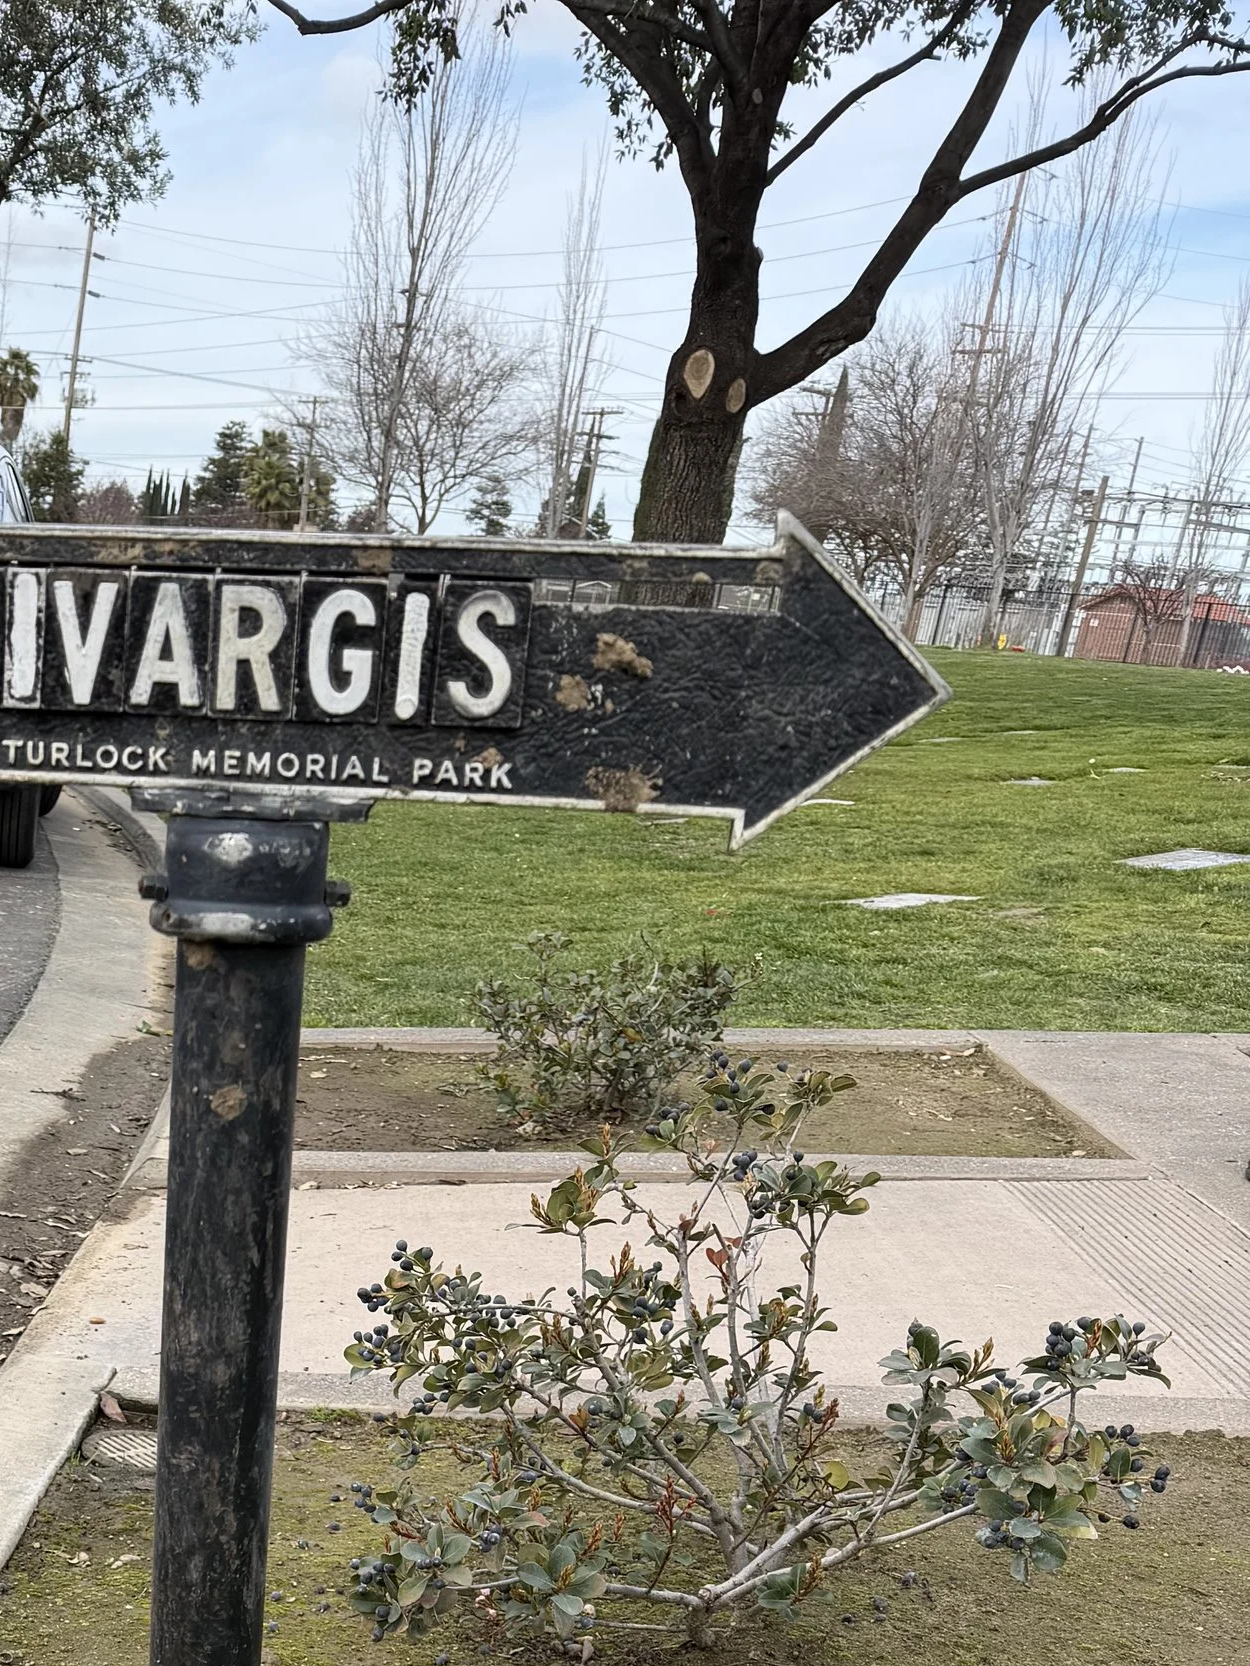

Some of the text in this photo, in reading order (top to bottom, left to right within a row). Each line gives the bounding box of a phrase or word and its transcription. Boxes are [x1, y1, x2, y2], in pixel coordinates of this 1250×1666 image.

[2, 739, 514, 790] TURLOCK MEMORIAL PARK
